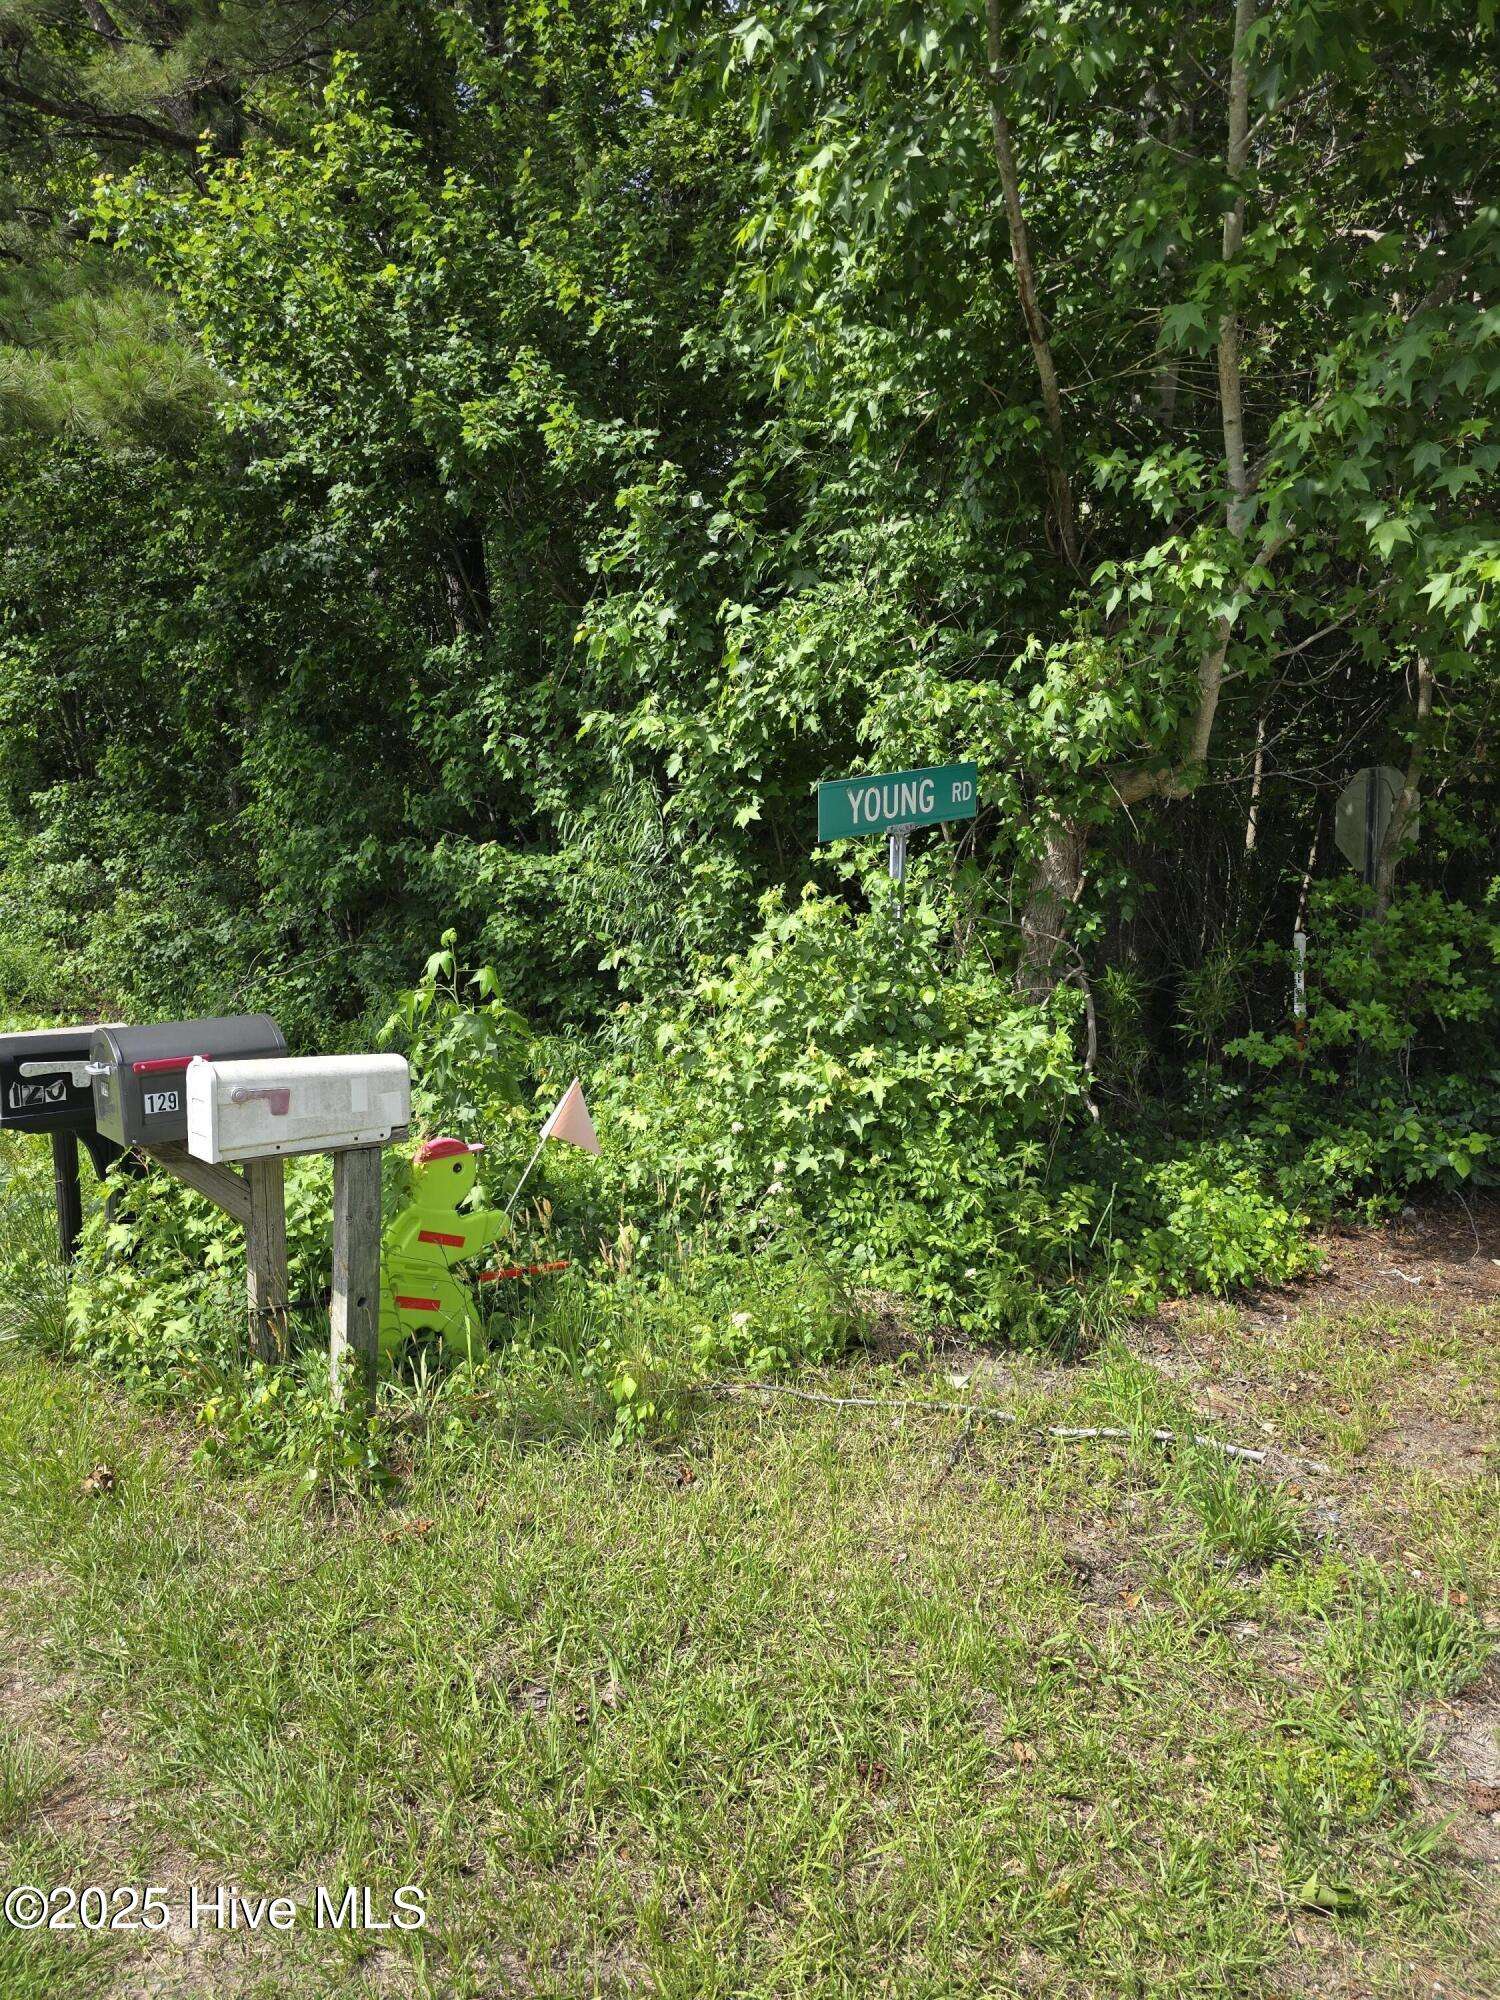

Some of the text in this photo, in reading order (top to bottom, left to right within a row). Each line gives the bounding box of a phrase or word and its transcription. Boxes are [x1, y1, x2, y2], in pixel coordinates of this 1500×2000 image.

[847, 779, 972, 824] YOUNG RD
[147, 1092, 176, 1112] 129
